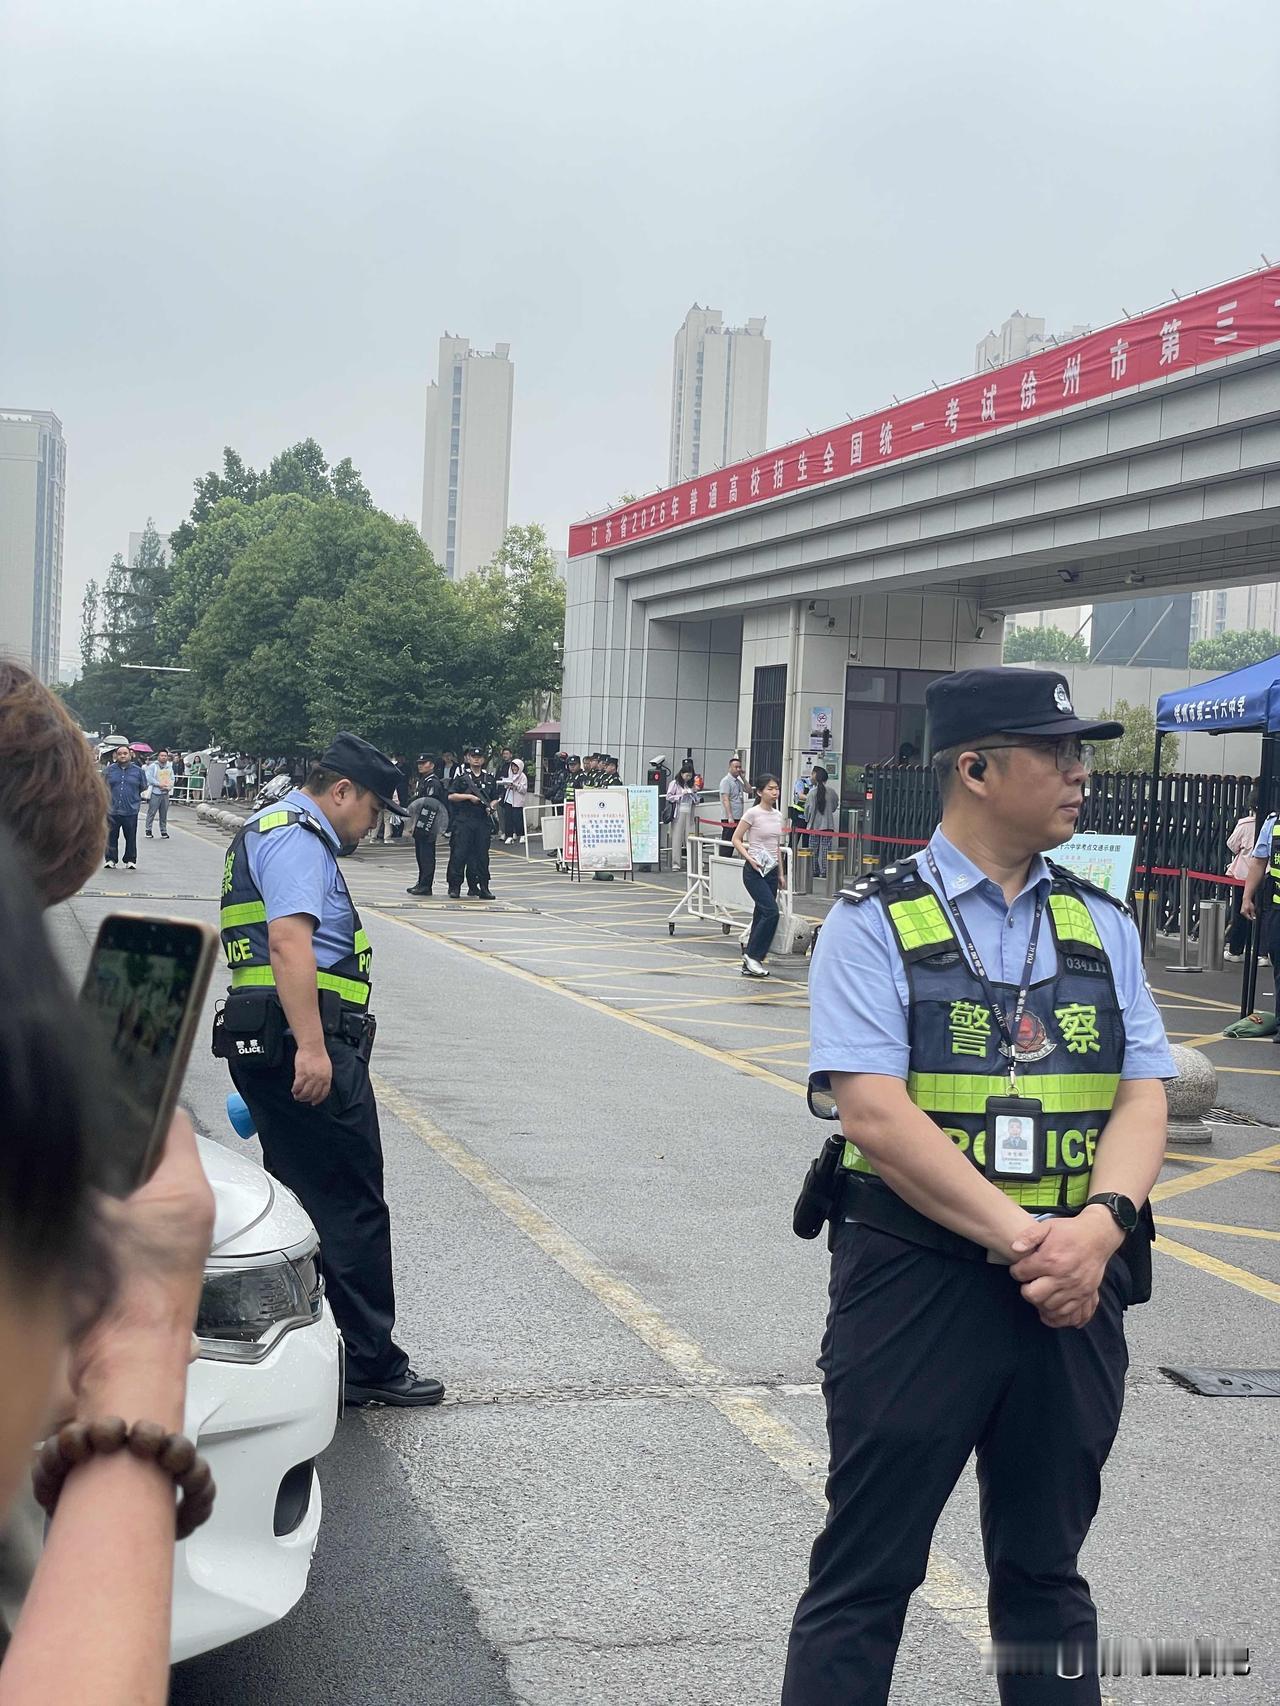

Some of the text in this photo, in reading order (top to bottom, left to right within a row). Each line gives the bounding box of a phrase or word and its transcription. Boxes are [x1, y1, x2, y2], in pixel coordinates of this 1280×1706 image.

[591, 299, 1280, 547] 江苏省2026年普通高校招生全国统一考试徐州市第三
[425, 811, 437, 832] POLICE
